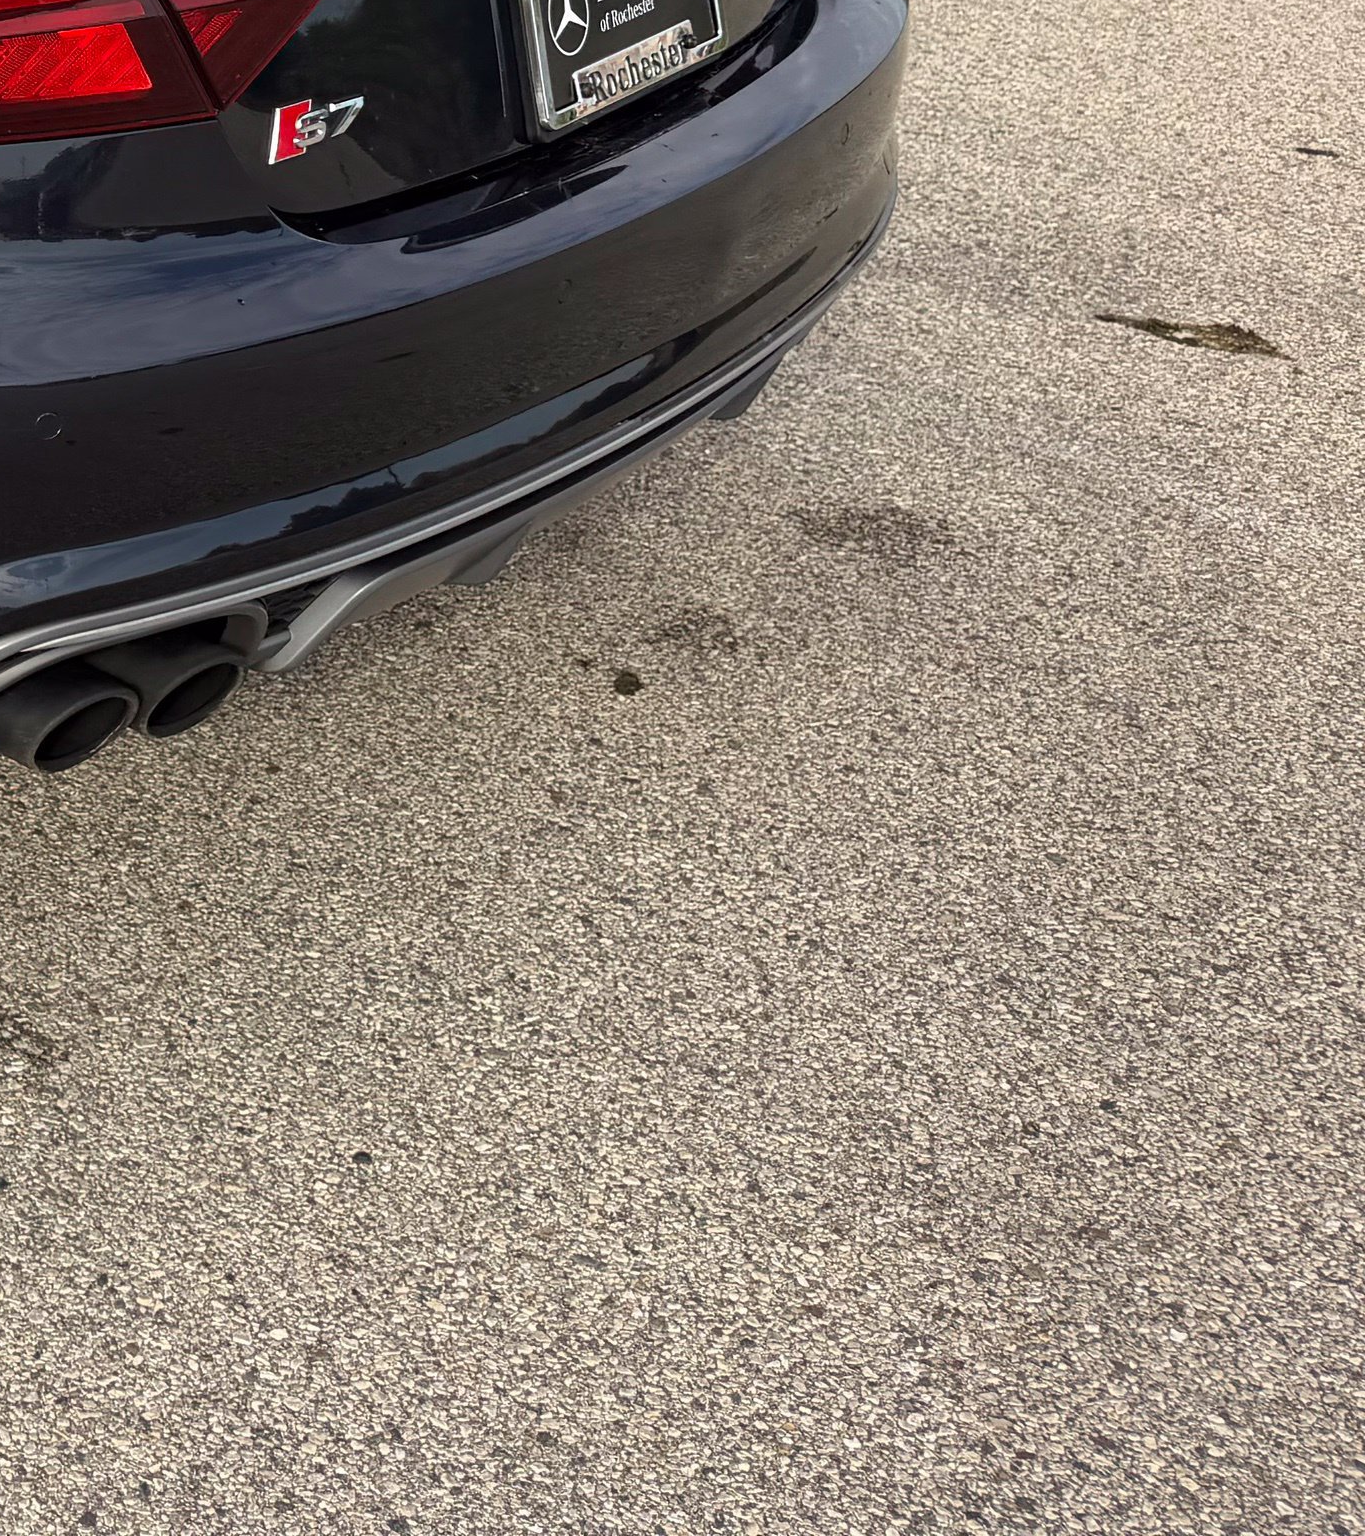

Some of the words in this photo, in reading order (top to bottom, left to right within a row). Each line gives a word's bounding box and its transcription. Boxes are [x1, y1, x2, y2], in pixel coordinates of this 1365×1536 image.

[600, 13, 612, 33] of
[588, 40, 688, 104] Rochester
[292, 95, 365, 148] S7
